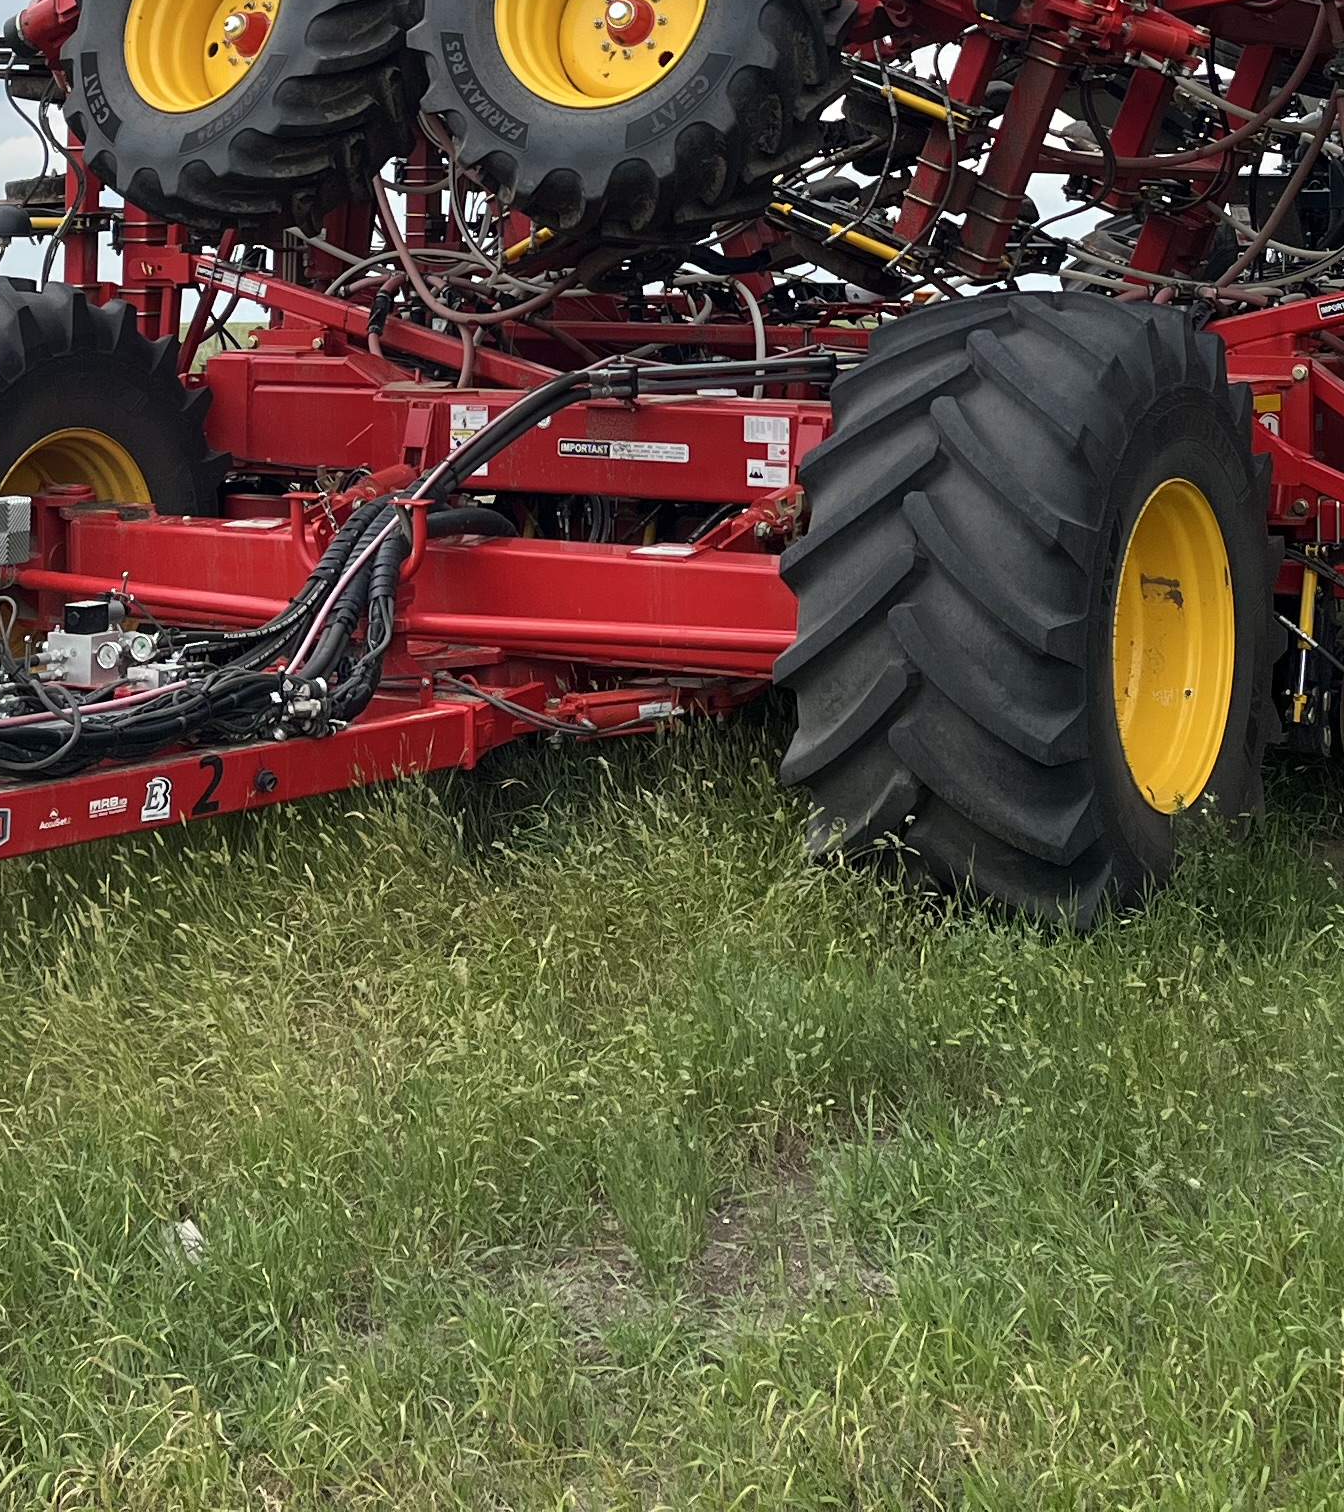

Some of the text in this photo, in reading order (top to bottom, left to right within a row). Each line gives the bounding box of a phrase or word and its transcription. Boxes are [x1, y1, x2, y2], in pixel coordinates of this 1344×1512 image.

[83, 72, 112, 126] CEAT
[446, 39, 524, 141] FARMAX R65
[650, 75, 710, 135] CEAT
[560, 442, 609, 455] IMPORTANT
[192, 755, 224, 816] 2
